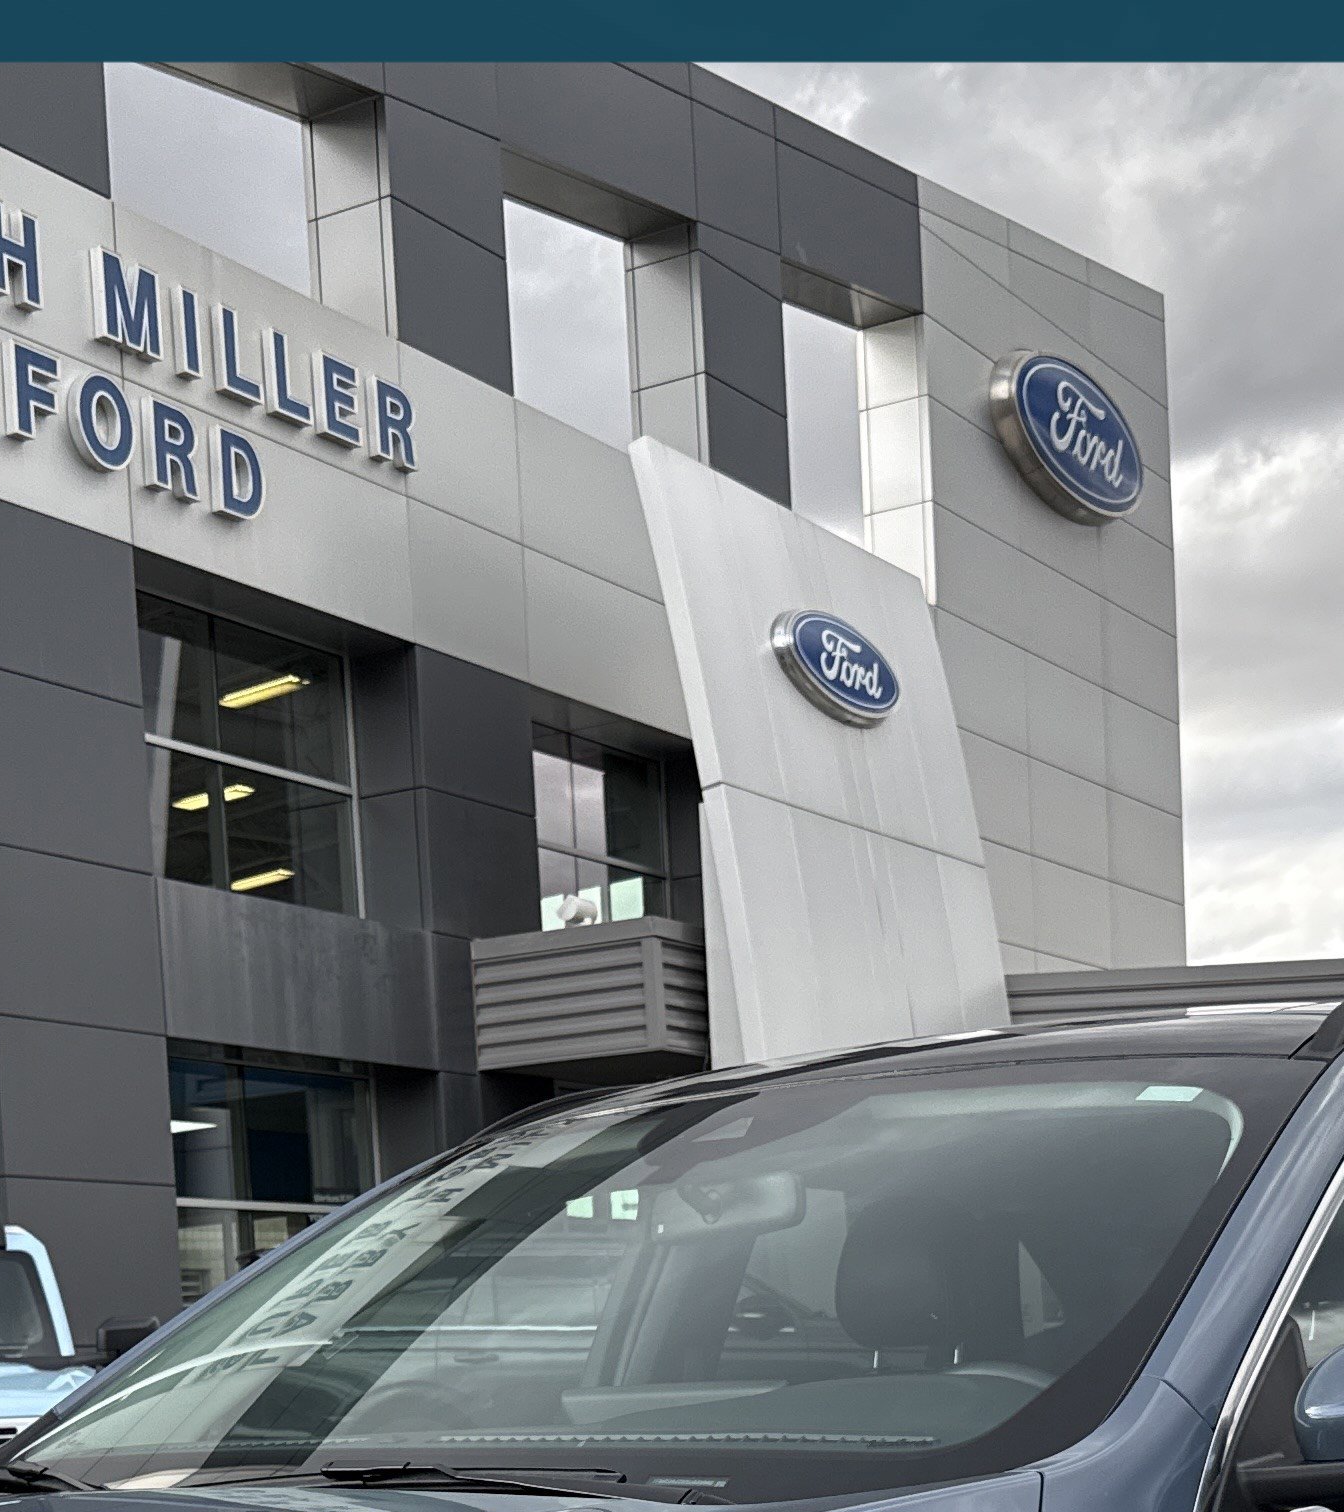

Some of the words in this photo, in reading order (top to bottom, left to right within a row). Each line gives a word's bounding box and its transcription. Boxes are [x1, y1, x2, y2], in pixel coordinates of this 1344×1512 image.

[3, 339, 266, 521] FORD
[92, 245, 419, 472] MILLER
[1050, 380, 1124, 488] Ford
[820, 630, 883, 699] Ford
